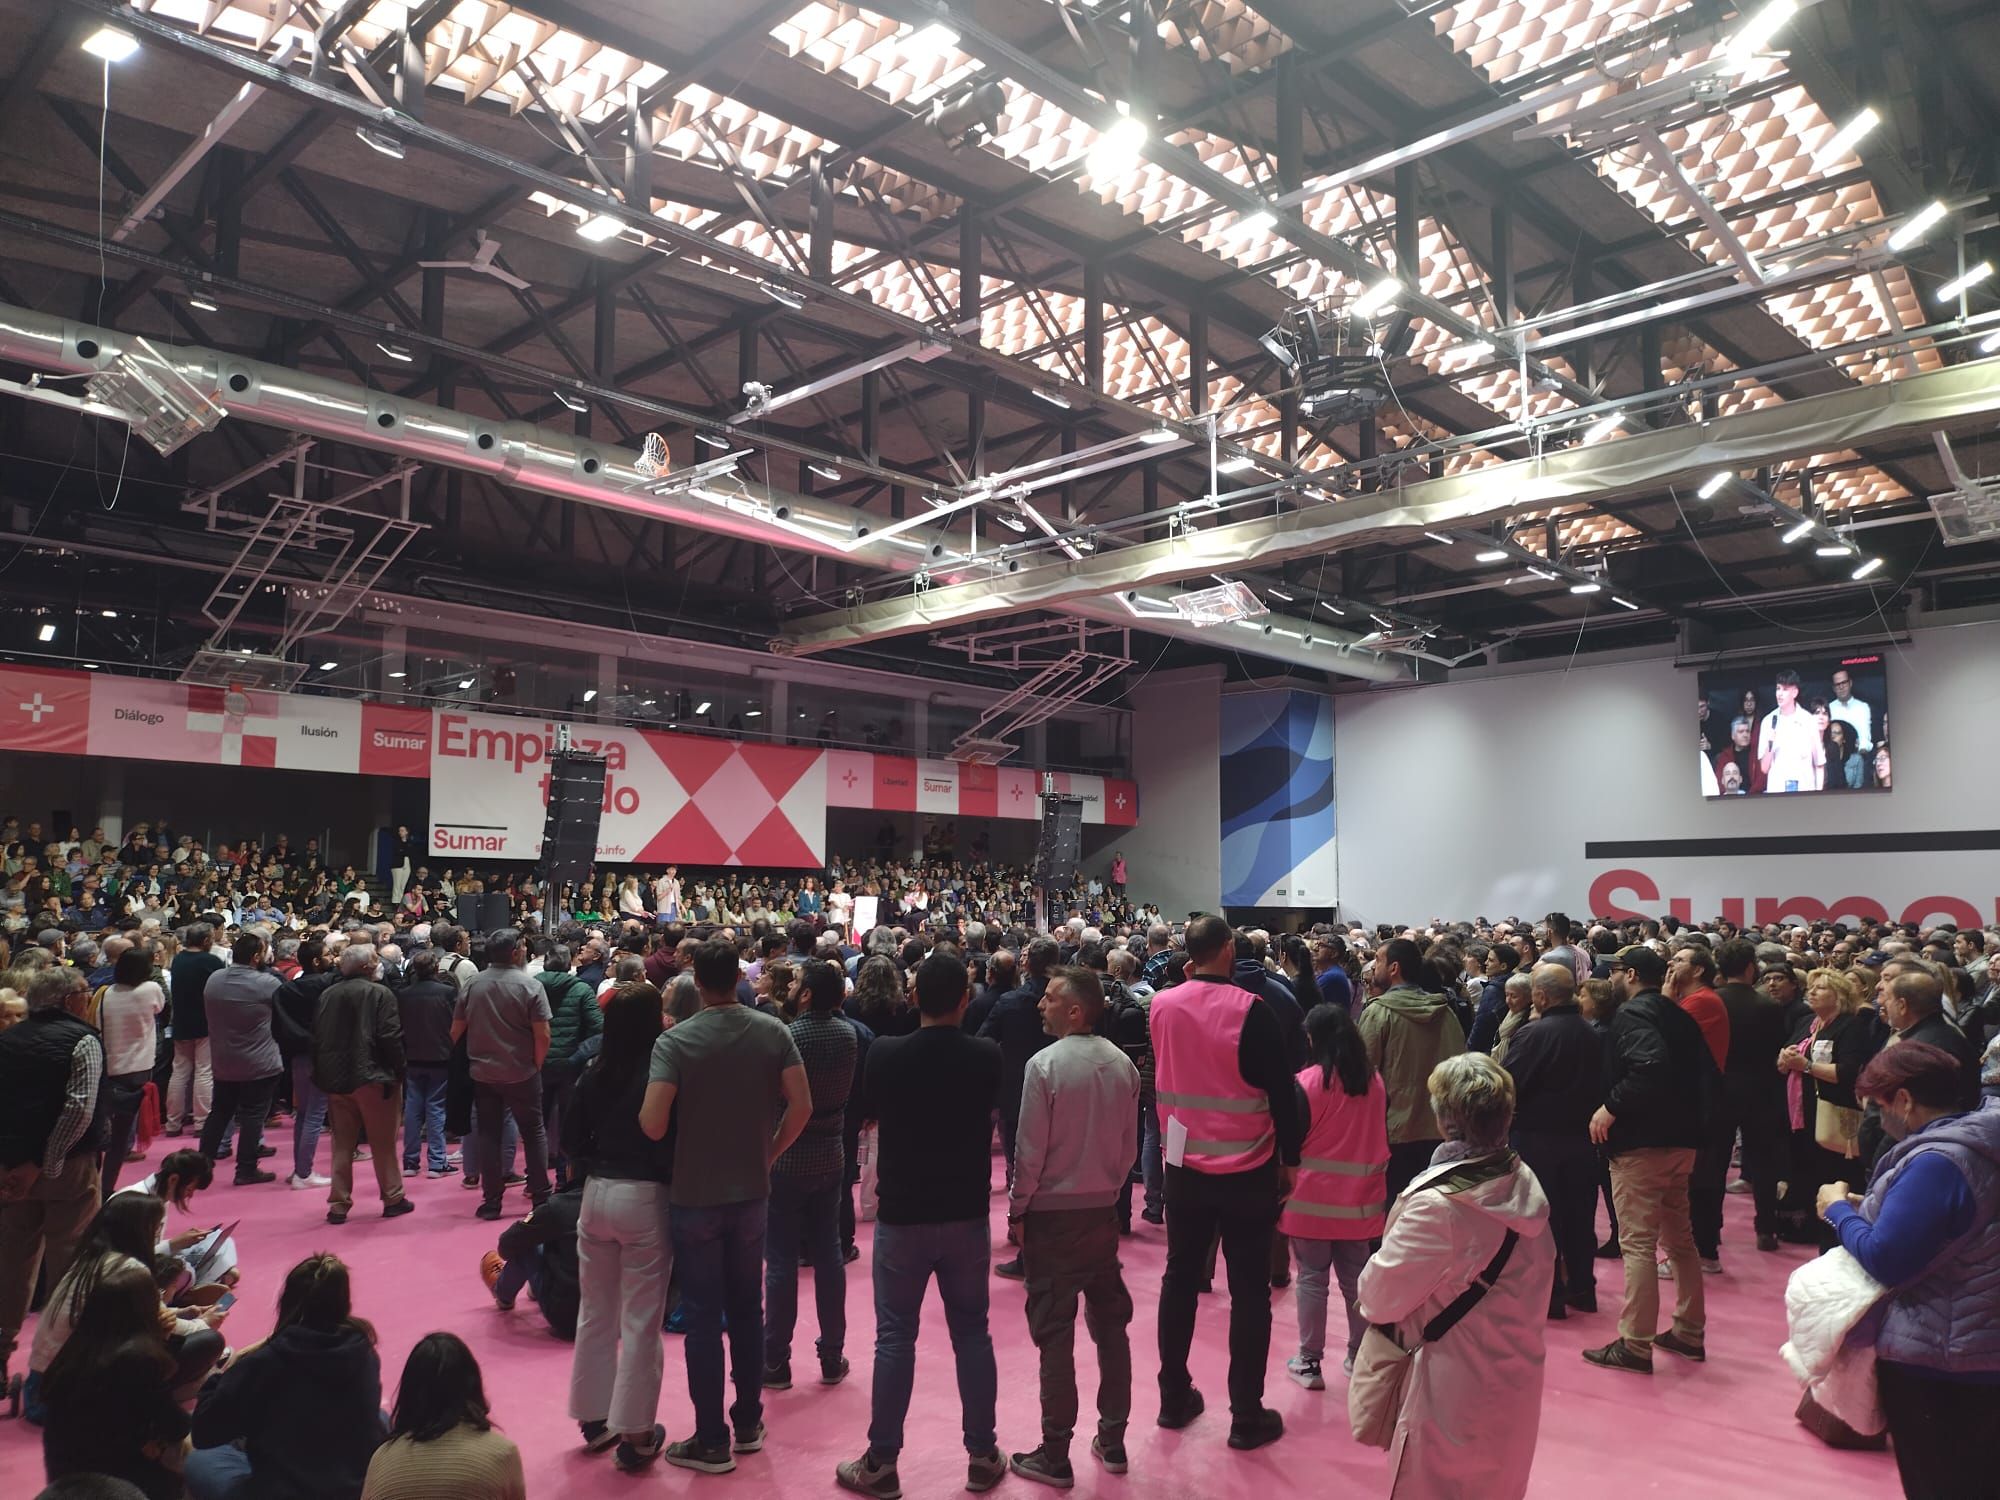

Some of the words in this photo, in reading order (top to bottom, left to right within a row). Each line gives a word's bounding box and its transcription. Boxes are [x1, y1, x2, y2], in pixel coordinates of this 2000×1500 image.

[114, 708, 164, 724] Diálogo
[301, 725, 338, 738] Ilusión
[373, 732, 426, 750] Sumar
[438, 714, 626, 773] Empiza
[923, 782, 952, 793] Sumar
[434, 829, 507, 851] Sumar
